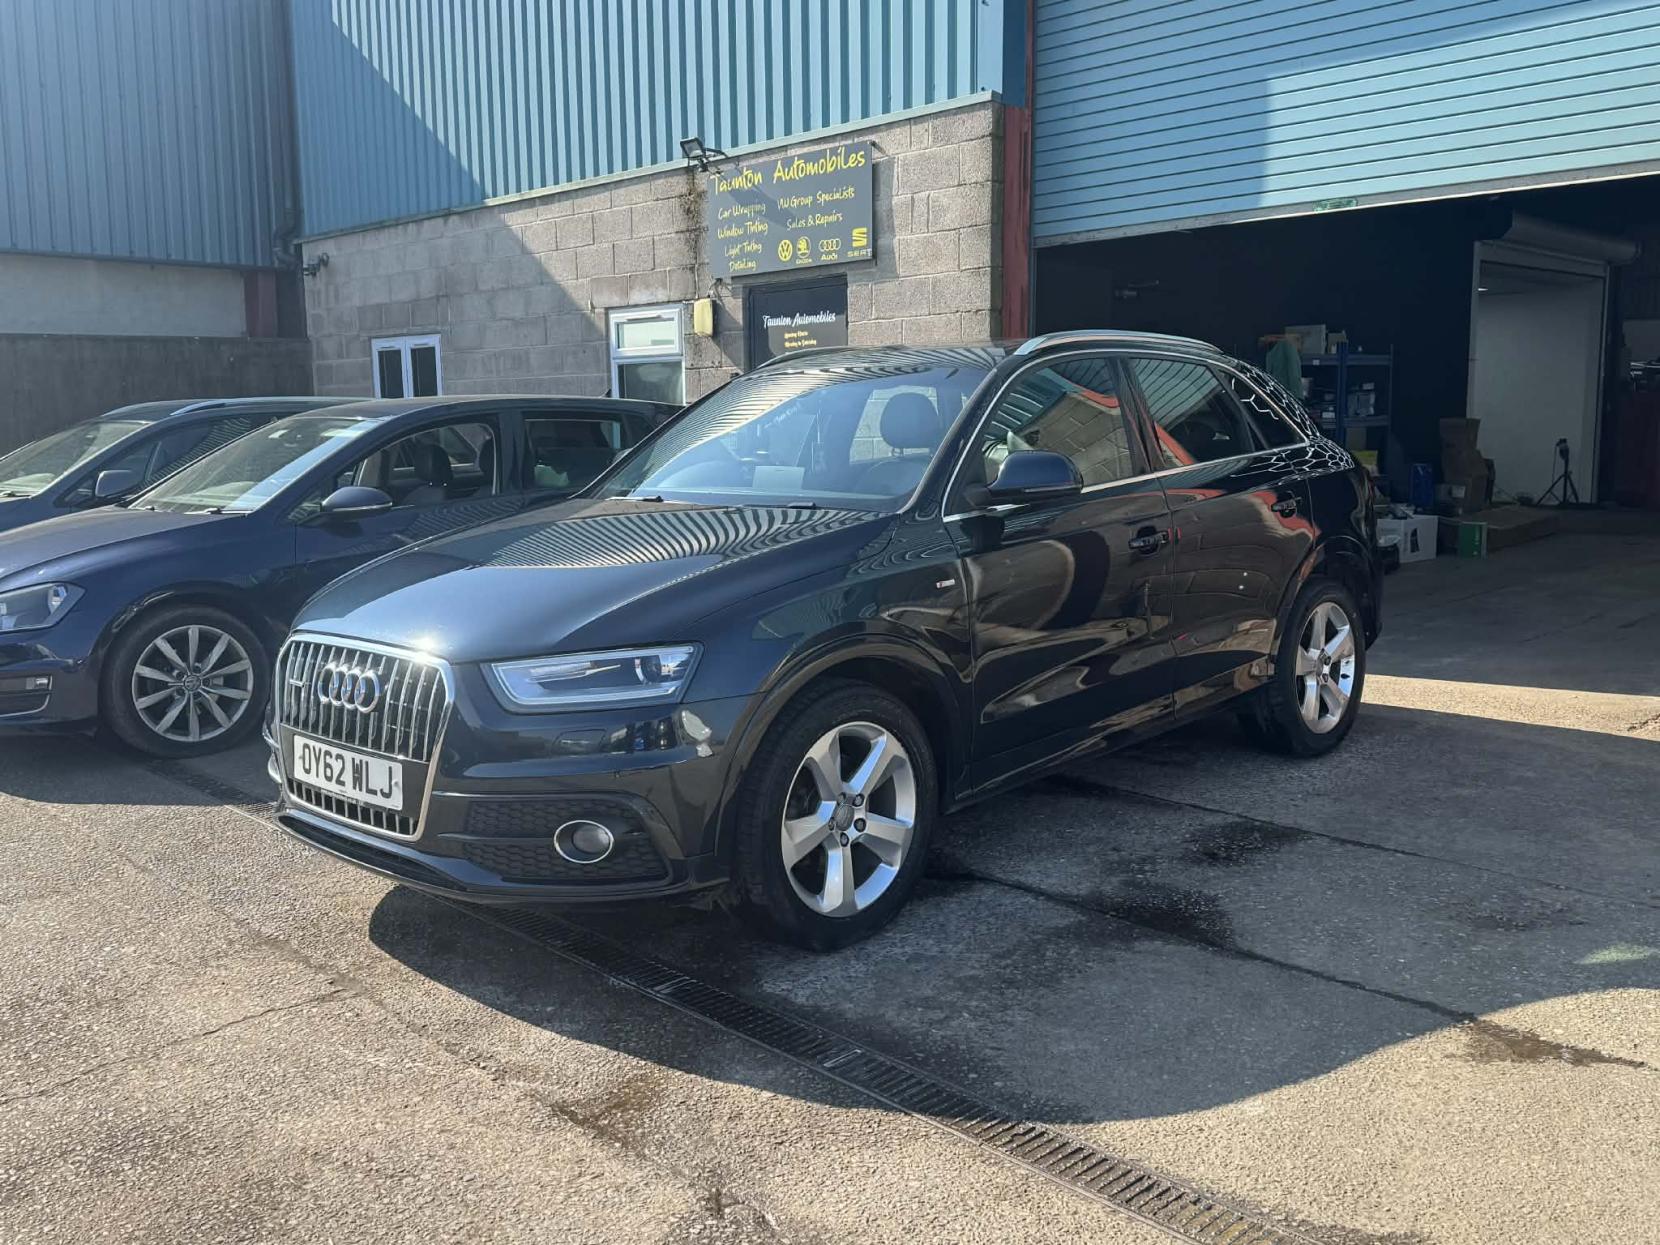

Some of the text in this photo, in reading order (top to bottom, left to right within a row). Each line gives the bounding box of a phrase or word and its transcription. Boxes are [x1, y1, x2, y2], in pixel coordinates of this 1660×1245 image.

[711, 147, 865, 195] Taunton Automobiles
[790, 195, 813, 208] Group
[816, 185, 855, 206] Specialists
[718, 207, 732, 220] Car
[786, 209, 843, 231] Sales & Repairs
[717, 223, 745, 240] Window
[302, 743, 393, 799] OY62 WLJ
